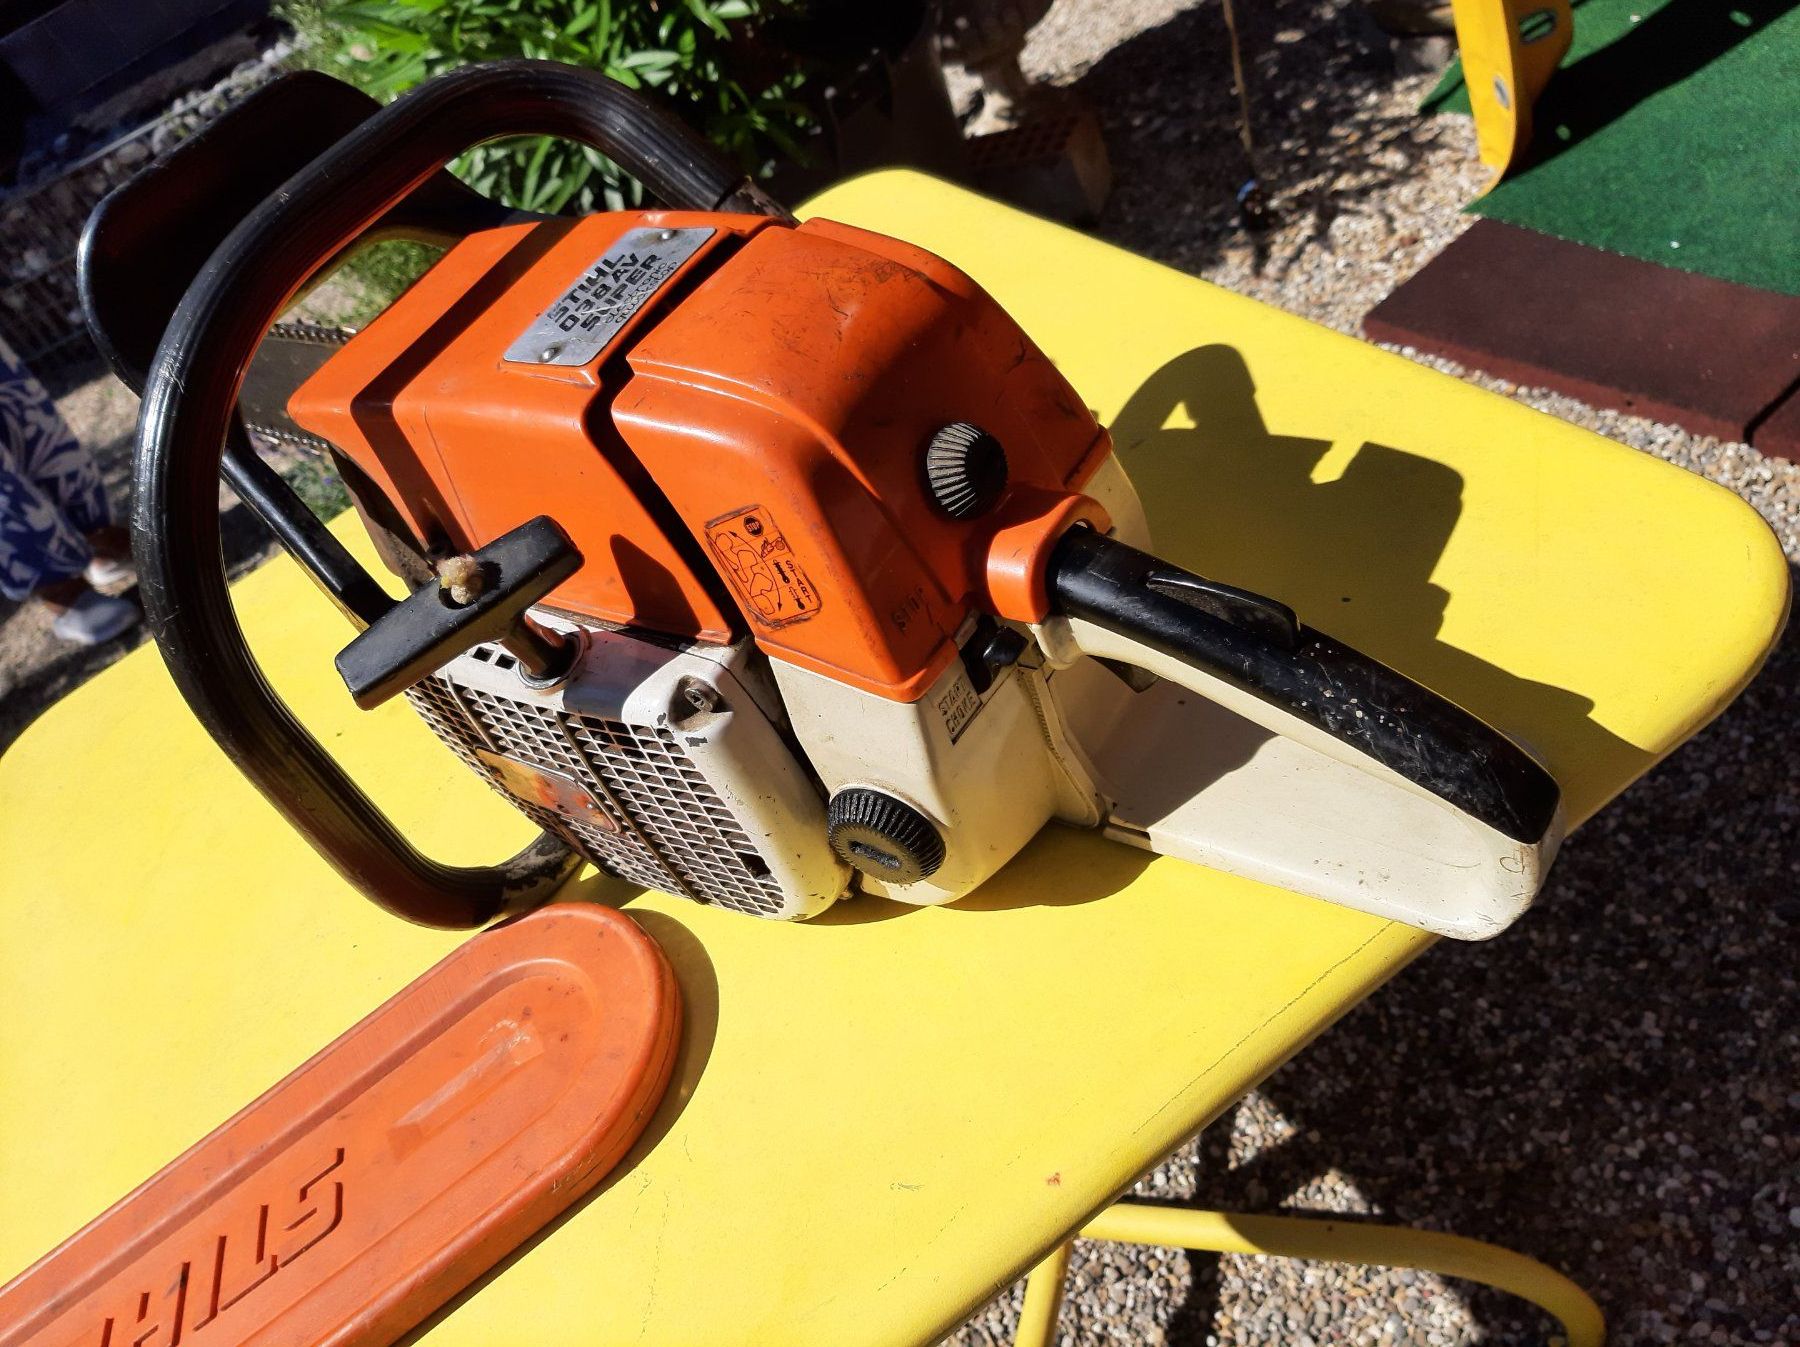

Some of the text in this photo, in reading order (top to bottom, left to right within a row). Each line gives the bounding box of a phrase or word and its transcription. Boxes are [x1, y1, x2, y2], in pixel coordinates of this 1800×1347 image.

[547, 254, 626, 323] STIHL
[559, 253, 639, 332] 038 AV
[580, 254, 662, 331] SUPER
[746, 521, 760, 532] STOP
[785, 560, 813, 603] START
[946, 691, 976, 735] CHOKE
